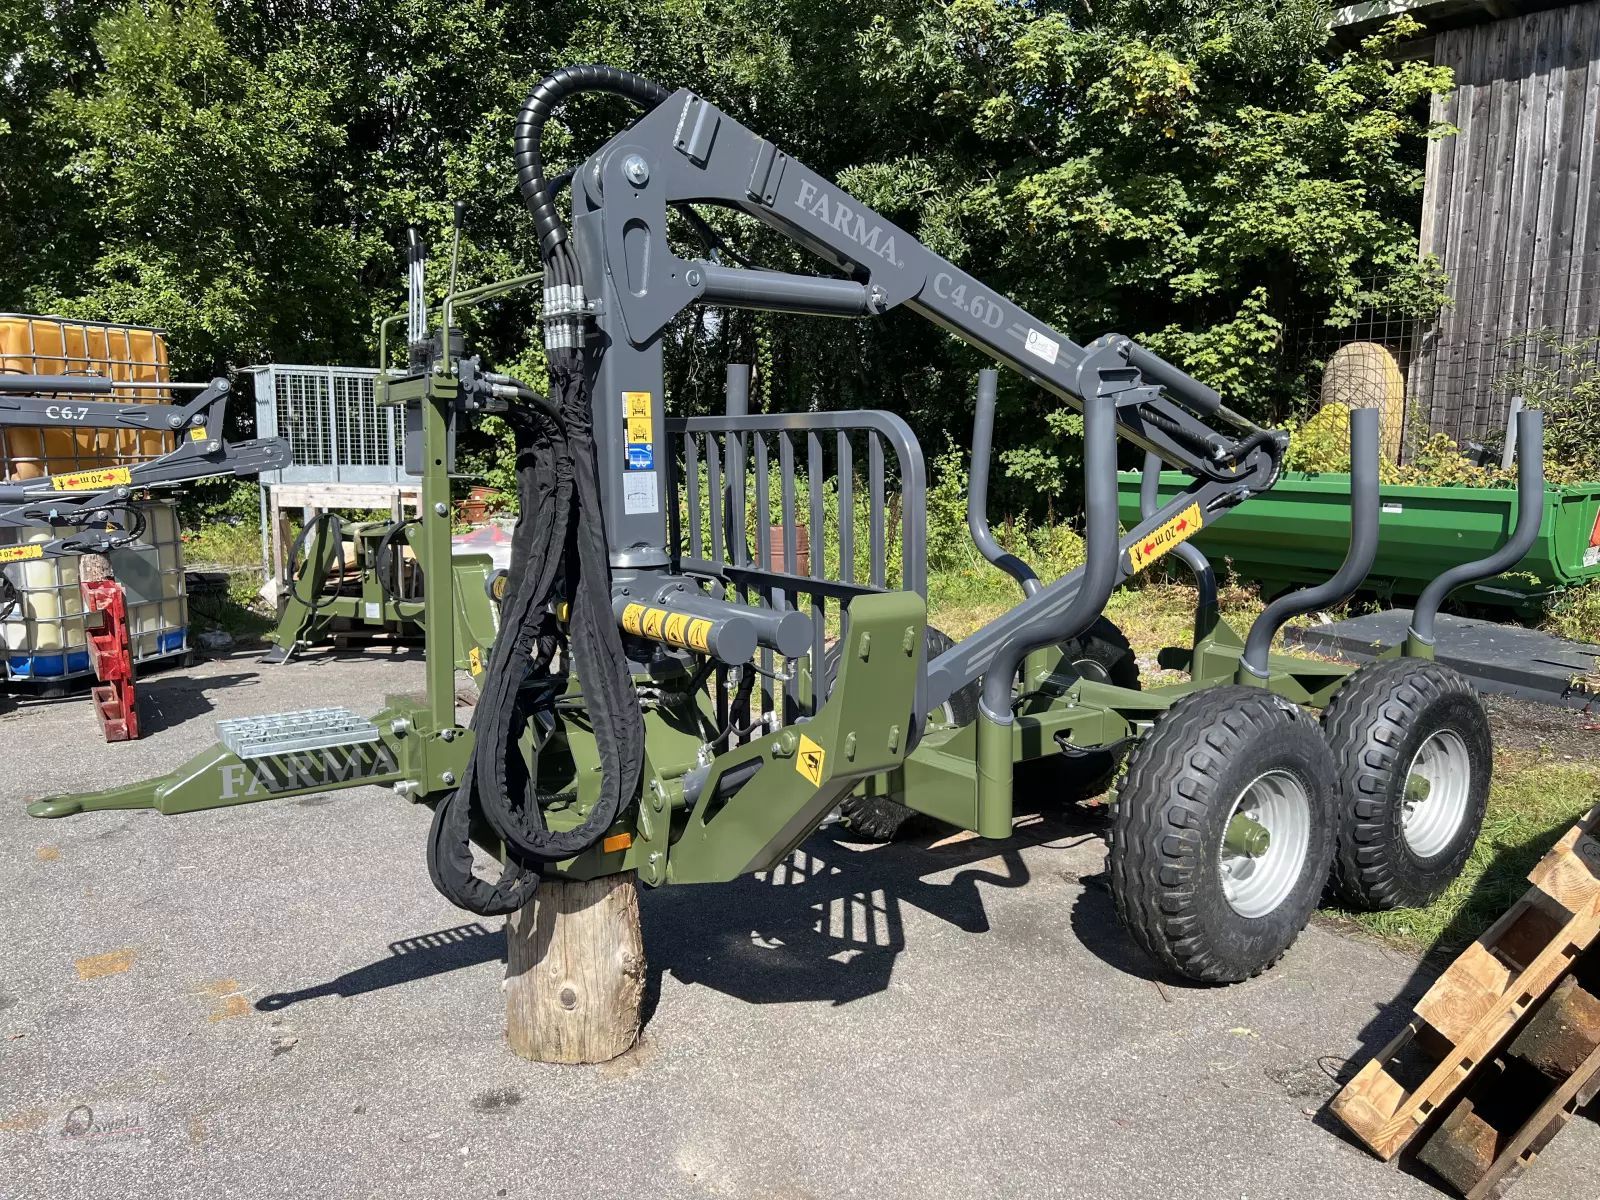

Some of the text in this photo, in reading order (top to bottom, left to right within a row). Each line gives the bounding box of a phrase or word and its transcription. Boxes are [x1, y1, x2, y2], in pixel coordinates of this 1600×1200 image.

[794, 178, 898, 266] FARMA
[933, 272, 1005, 329] C4.6D
[45, 405, 89, 420] C6.7
[79, 474, 103, 484] 20 m
[1155, 525, 1177, 545] 20 m
[217, 744, 401, 800] FARMA
